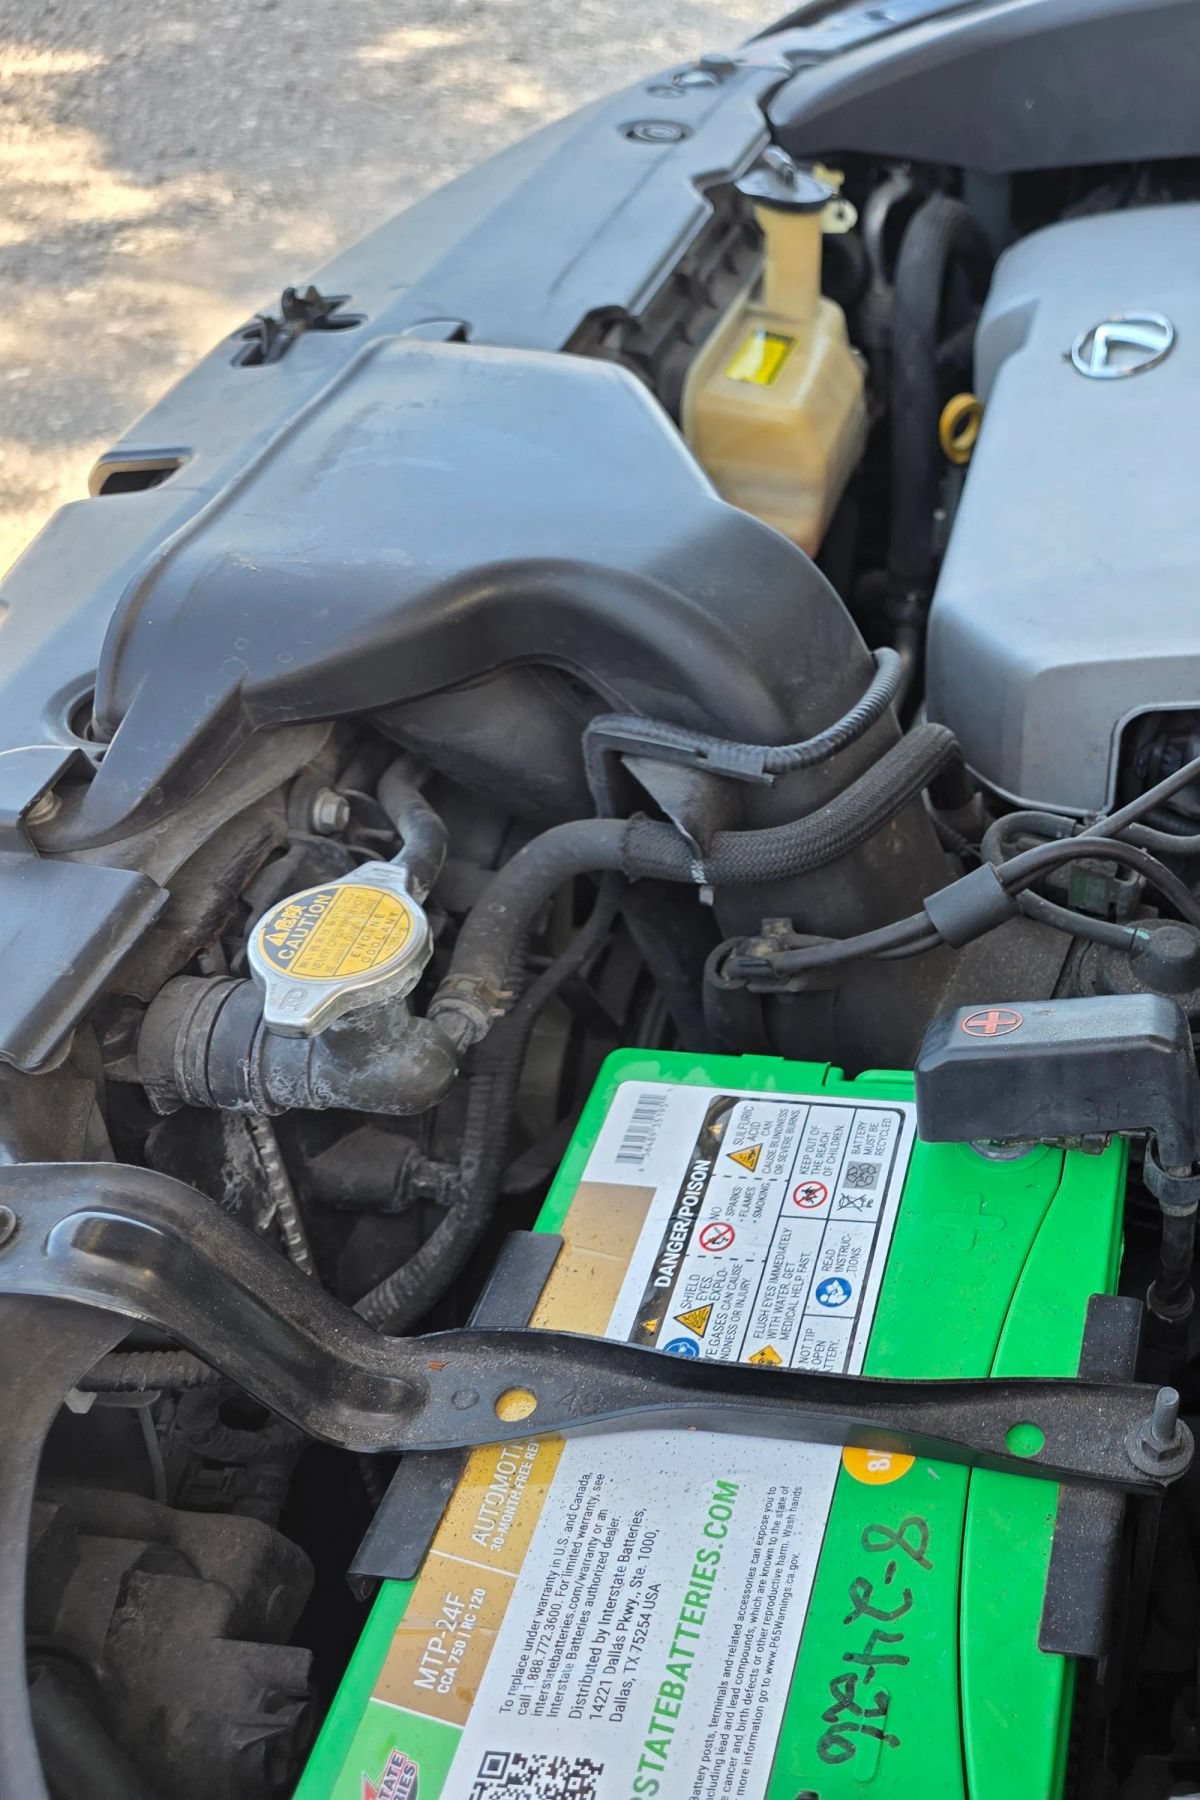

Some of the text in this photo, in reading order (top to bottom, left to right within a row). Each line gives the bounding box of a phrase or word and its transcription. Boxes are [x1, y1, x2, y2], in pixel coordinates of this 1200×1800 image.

[278, 894, 331, 960] CAUTION
[350, 913, 385, 958] ENGINE
[361, 911, 399, 963] COOLANT
[732, 1105, 754, 1145] SULFURIC
[746, 1121, 761, 1142] ACID
[760, 1120, 773, 1136] CAN
[761, 1108, 789, 1174] CAUSE BLINDNESS
[850, 1120, 867, 1154] BATTERY
[862, 1122, 879, 1155] MUST BE
[776, 1135, 793, 1162] SEVERE
[799, 1125, 820, 1174] KEEP OUT OF
[809, 1131, 830, 1175] THE REACH
[773, 1163, 784, 1174] OR
[821, 1165, 832, 1176] OF
[707, 1206, 722, 1220] NO
[724, 1186, 742, 1216] SPARKS
[738, 1186, 756, 1217] FLAMES
[751, 1182, 770, 1218] SMOKING
[653, 1159, 711, 1287] DANGER/POISON
[820, 1248, 835, 1271] READ
[833, 1233, 851, 1272] INSTRUC-
[679, 1273, 700, 1309] SHIELD
[708, 1267, 728, 1301] EXPLO-
[726, 1263, 743, 1290] CAUSE
[752, 1227, 792, 1338] FLUSH EYES IMMEDIATELY
[720, 1291, 734, 1310] CAN
[730, 1309, 742, 1322] OR
[765, 1261, 795, 1340] WITH WATER. GET
[778, 1300, 799, 1340] MEDICAL
[790, 1274, 804, 1298] HELP
[708, 1312, 728, 1346] GASES
[797, 1327, 815, 1363] NOT TIP
[810, 1339, 826, 1365] OPEN
[763, 1496, 774, 1512] you
[765, 1486, 776, 1495] to
[779, 1485, 789, 1494] of
[787, 1486, 802, 1511] hands
[490, 1490, 521, 1551] 30-MONTH
[514, 1462, 532, 1490] FREE
[774, 1496, 787, 1518] state
[755, 1514, 769, 1545] expose
[767, 1536, 778, 1545] to
[770, 1520, 781, 1534] the
[781, 1514, 795, 1537] Wash
[750, 1547, 761, 1564] can
[758, 1547, 774, 1577] known
[774, 1540, 789, 1566] harm.
[498, 1471, 593, 1713] To replace under warranty in U.S. and Canada,
[517, 1473, 605, 1715] call 1.888.772.3600. For limited warranty, see
[736, 1566, 756, 1621] accessories
[756, 1578, 766, 1593] are
[762, 1567, 783, 1625] reproductive
[530, 1508, 608, 1716] interstatebatteries.com/warranty or an
[545, 1515, 621, 1717] Interstate Batteries authorized dealer.
[567, 1508, 647, 1719] Distributed by Interstate Batteries,
[588, 1529, 660, 1719] 14221 Dallas Pkwy., Ste. 1000,
[749, 1596, 762, 1623] which
[413, 1592, 464, 1689] MTP-24F
[436, 1667, 456, 1693] CCA
[447, 1639, 466, 1663] 750
[459, 1613, 476, 1629] RC
[468, 1588, 485, 1609] 120
[608, 1583, 661, 1722] Dallas, TX 75254 USA
[629, 1479, 739, 1800] STATEBATTERIES.COM
[727, 1623, 742, 1657] related
[734, 1626, 757, 1685] compounds,
[756, 1627, 768, 1652] other
[722, 1657, 733, 1677] and
[753, 1654, 761, 1665] or
[726, 1687, 740, 1708] lead
[742, 1668, 759, 1705] defects
[758, 1689, 768, 1703] go
[760, 1677, 771, 1687] to
[707, 1680, 728, 1727] terminals
[734, 1707, 749, 1731] birth
[723, 1711, 734, 1730] and
[743, 1705, 764, 1765] information
[701, 1730, 717, 1762] posts,
[714, 1733, 729, 1755] lead
[732, 1734, 743, 1753] and
[722, 1756, 737, 1792] cancer
[736, 1768, 749, 1795] more
